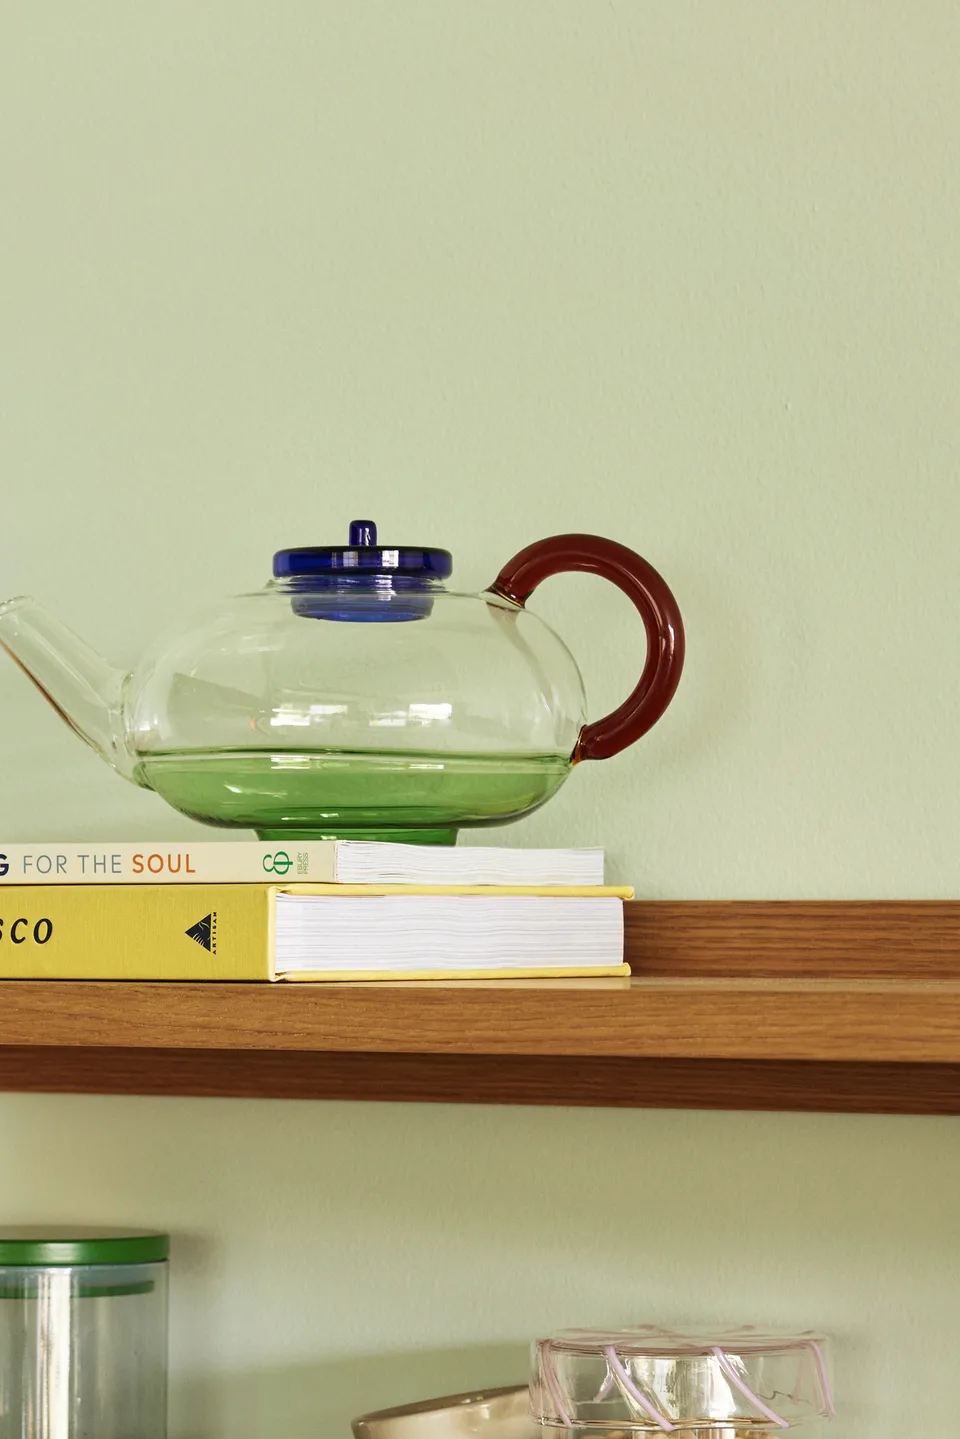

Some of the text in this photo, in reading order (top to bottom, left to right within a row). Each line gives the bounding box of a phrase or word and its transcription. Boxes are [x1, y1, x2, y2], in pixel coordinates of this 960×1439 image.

[23, 854, 68, 874] FOR
[77, 854, 122, 874] THE
[132, 853, 196, 874] SOUL
